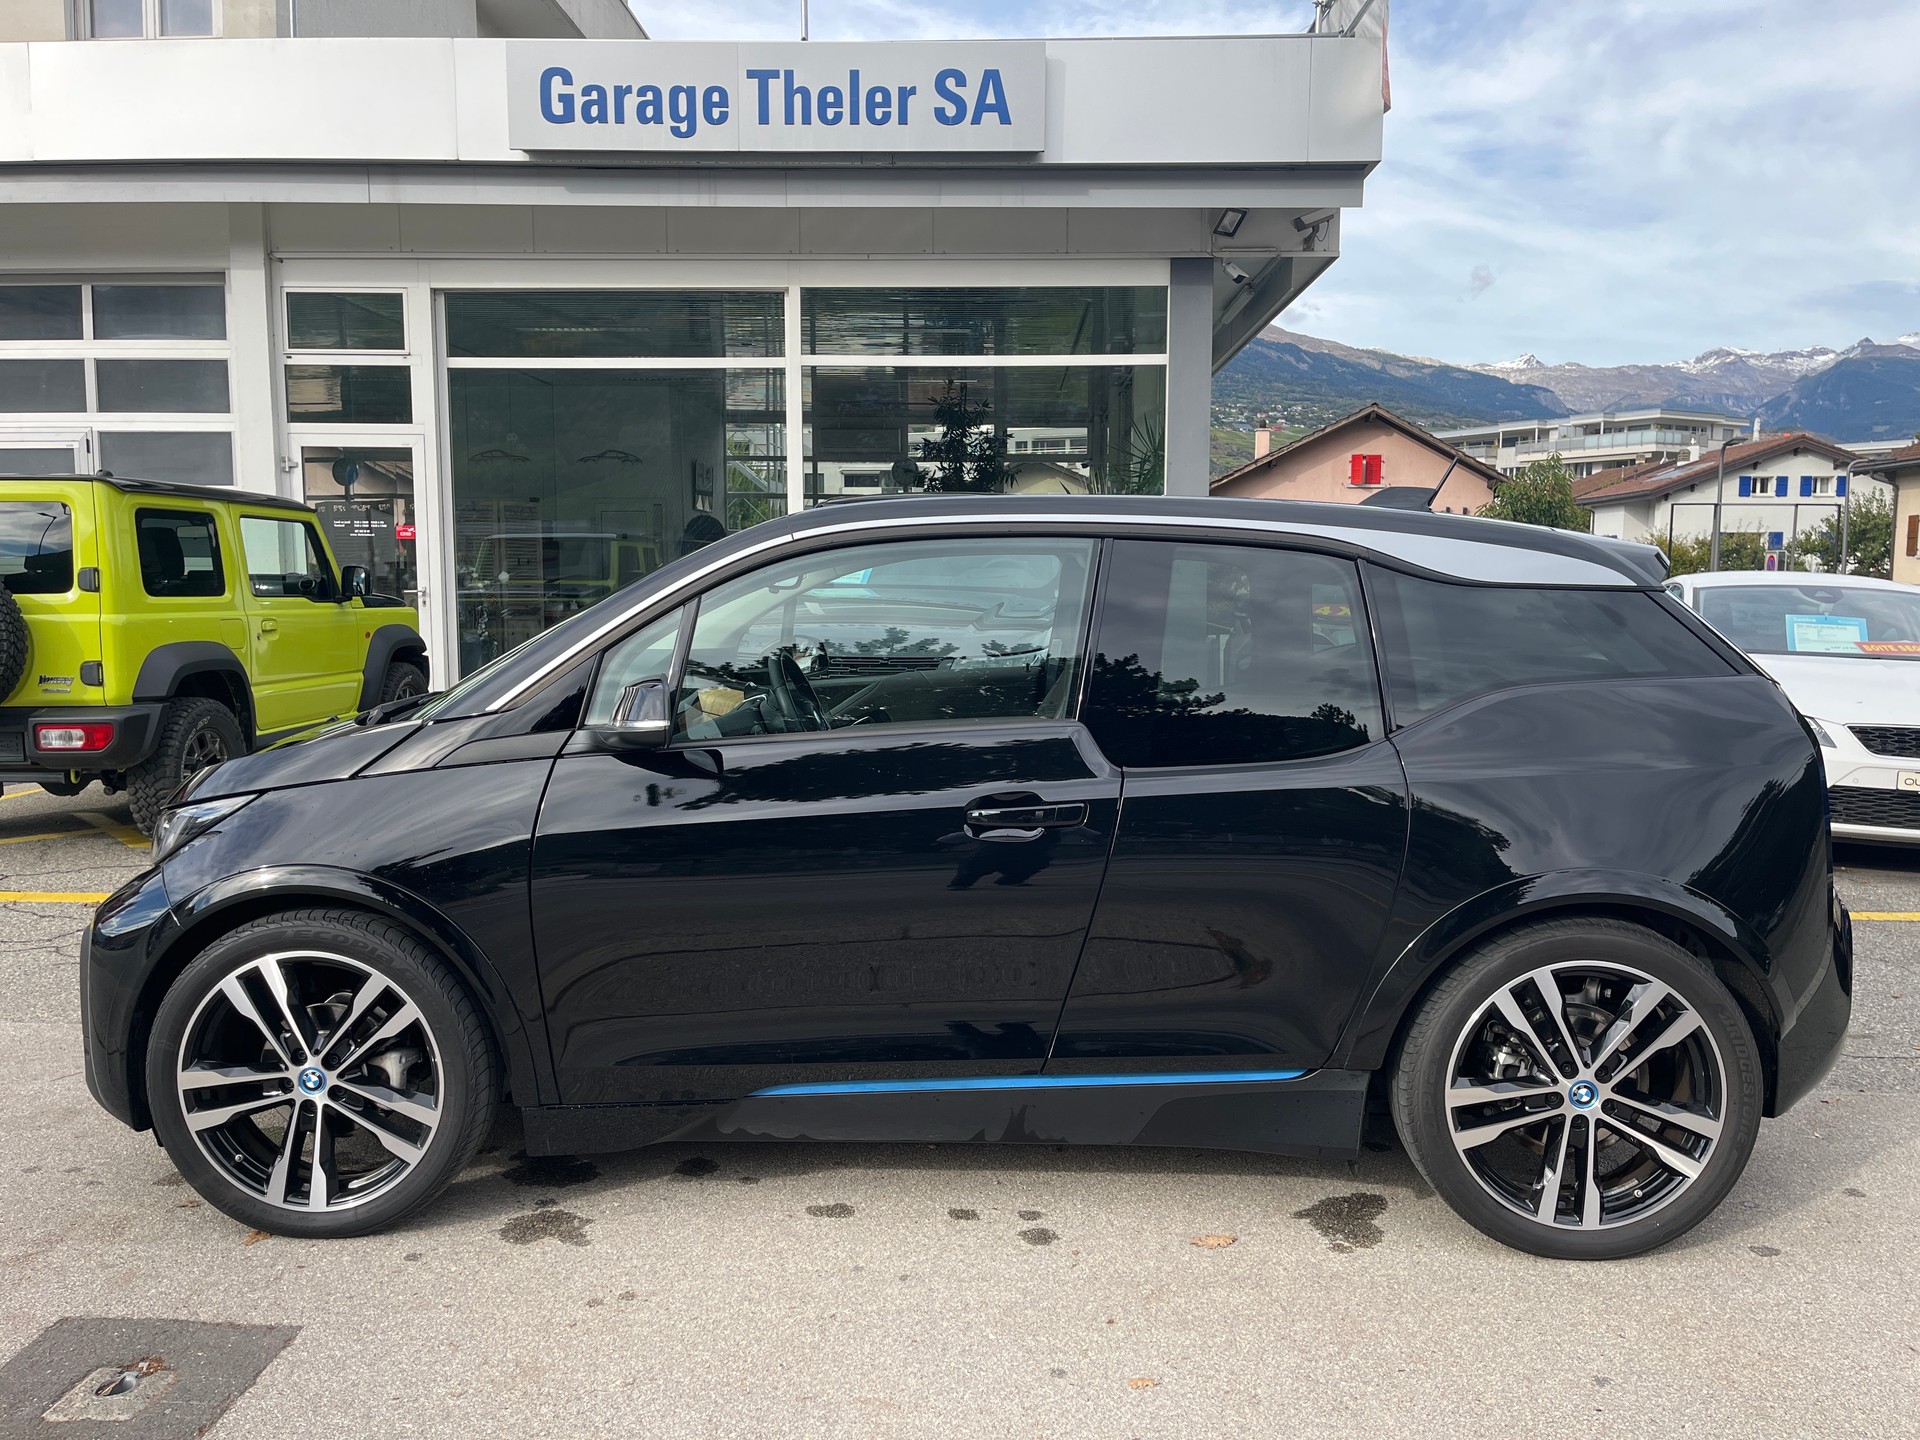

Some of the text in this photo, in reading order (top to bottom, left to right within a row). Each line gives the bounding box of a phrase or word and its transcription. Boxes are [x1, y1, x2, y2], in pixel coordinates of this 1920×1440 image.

[540, 66, 1012, 138] Garage Theler SA
